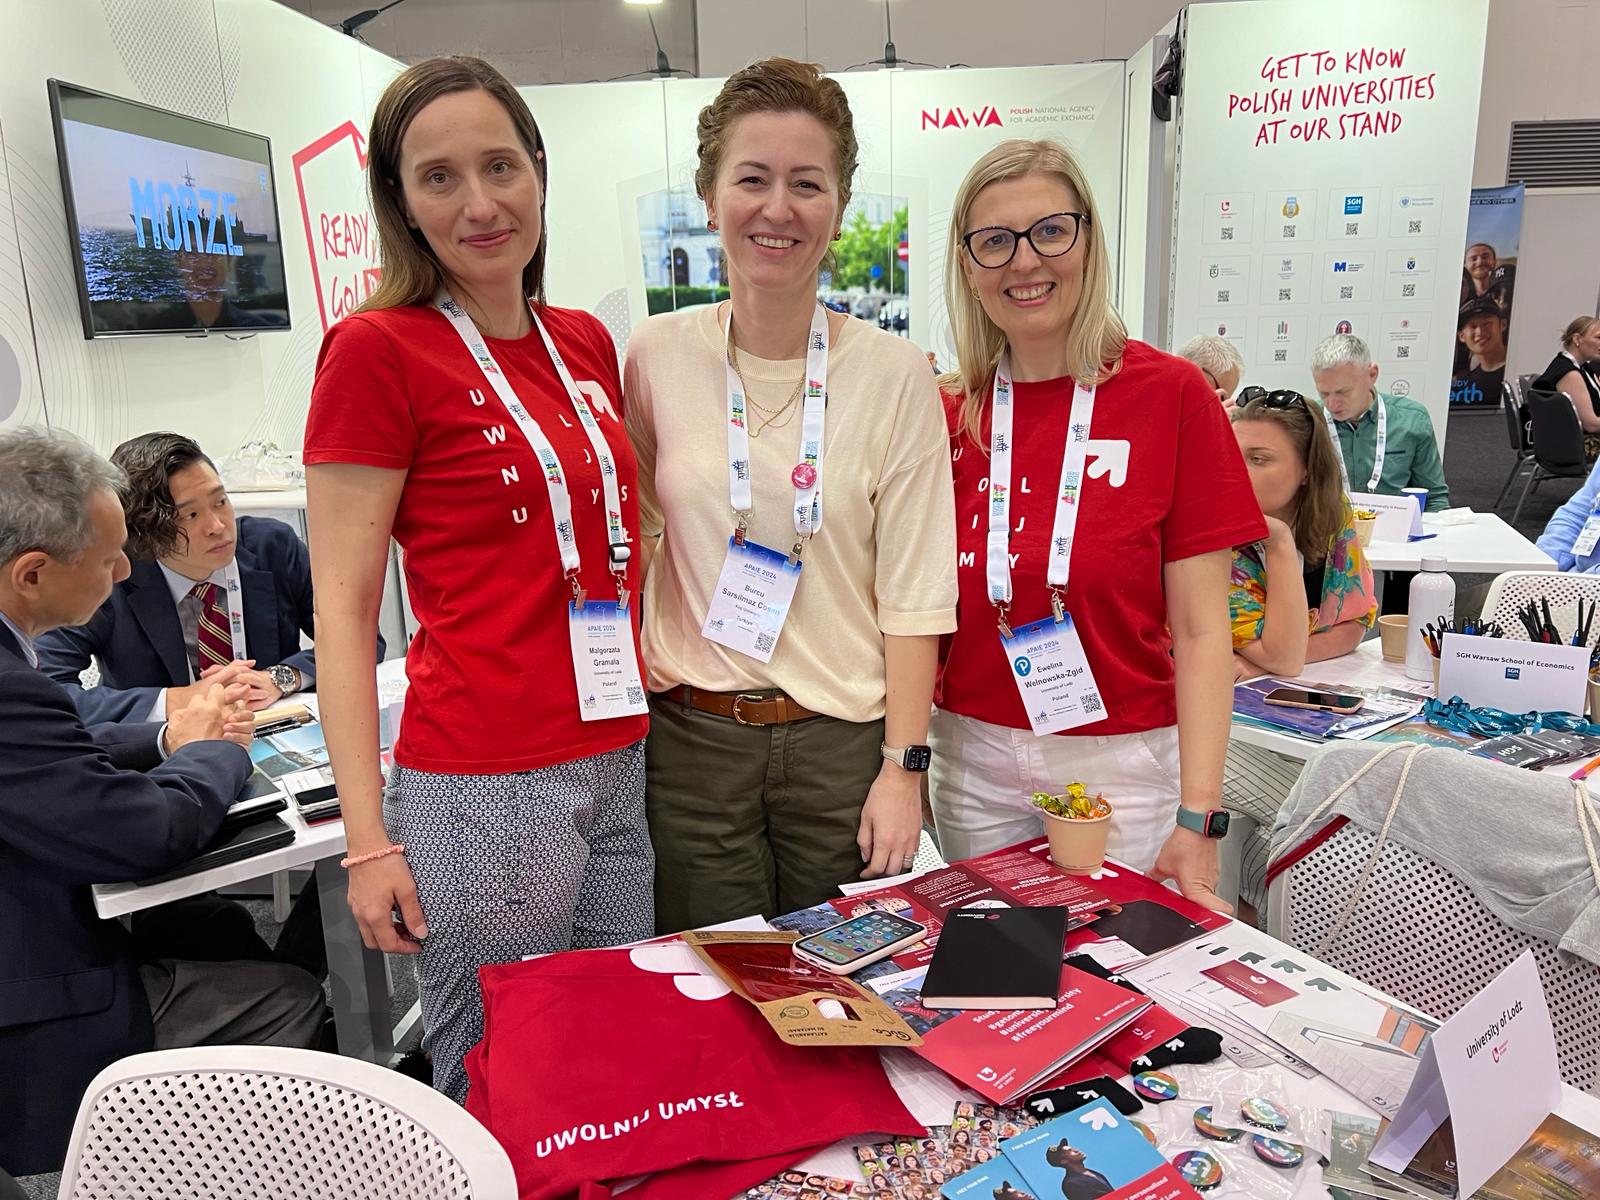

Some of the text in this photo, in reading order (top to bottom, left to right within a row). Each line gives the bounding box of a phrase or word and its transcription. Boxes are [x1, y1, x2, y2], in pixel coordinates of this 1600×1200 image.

[1261, 47, 1407, 82] GET TO KNOW
[1228, 73, 1438, 118] POLISH UNIVERSITIES
[922, 105, 1004, 130] NAWA
[1010, 105, 1095, 115] POLISH NATIONAL AGENCY
[1025, 115, 1059, 123] ACADEMIC
[1061, 113, 1095, 121] EXCHANGE
[1254, 110, 1403, 147] AT OUR STAND
[1347, 197, 1361, 206] SGH
[129, 176, 244, 257] MORZE
[1452, 379, 1469, 387] UDY
[469, 389, 485, 407] U
[1449, 382, 1484, 404] erth
[482, 424, 506, 445] W
[501, 465, 519, 486] N
[978, 477, 1031, 493] O L
[512, 507, 528, 524] U
[972, 514, 1025, 532] I J
[959, 553, 974, 568] M
[744, 563, 777, 580] APAIE 2024
[722, 587, 756, 607] Sarsilmaz
[744, 585, 765, 598] Burcu
[589, 646, 621, 655] Malgorzata
[1026, 640, 1059, 654] APAIE 2024
[593, 658, 620, 667] Gramala
[1036, 661, 1063, 673] Ewelina
[1456, 651, 1471, 659] SGH
[1472, 653, 1500, 663] Warsaw
[1501, 656, 1525, 666] School
[1536, 660, 1575, 671] Economics
[1052, 694, 1069, 702] Poland
[1498, 744, 1523, 757] SGH
[939, 887, 993, 908] ACCREDITATIONS
[1058, 986, 1084, 1004] ersity
[987, 1010, 1025, 1031] #geton
[1011, 1002, 1075, 1043] #freeyourmind
[1466, 1019, 1500, 1059] University
[1500, 1011, 1508, 1027] of
[1506, 999, 1524, 1021] Lodz
[992, 1067, 1018, 1087] UNIVERSITY
[535, 1090, 745, 1159] UWOLNIJ UMYSŁ
[1128, 1176, 1169, 1200] personalized
